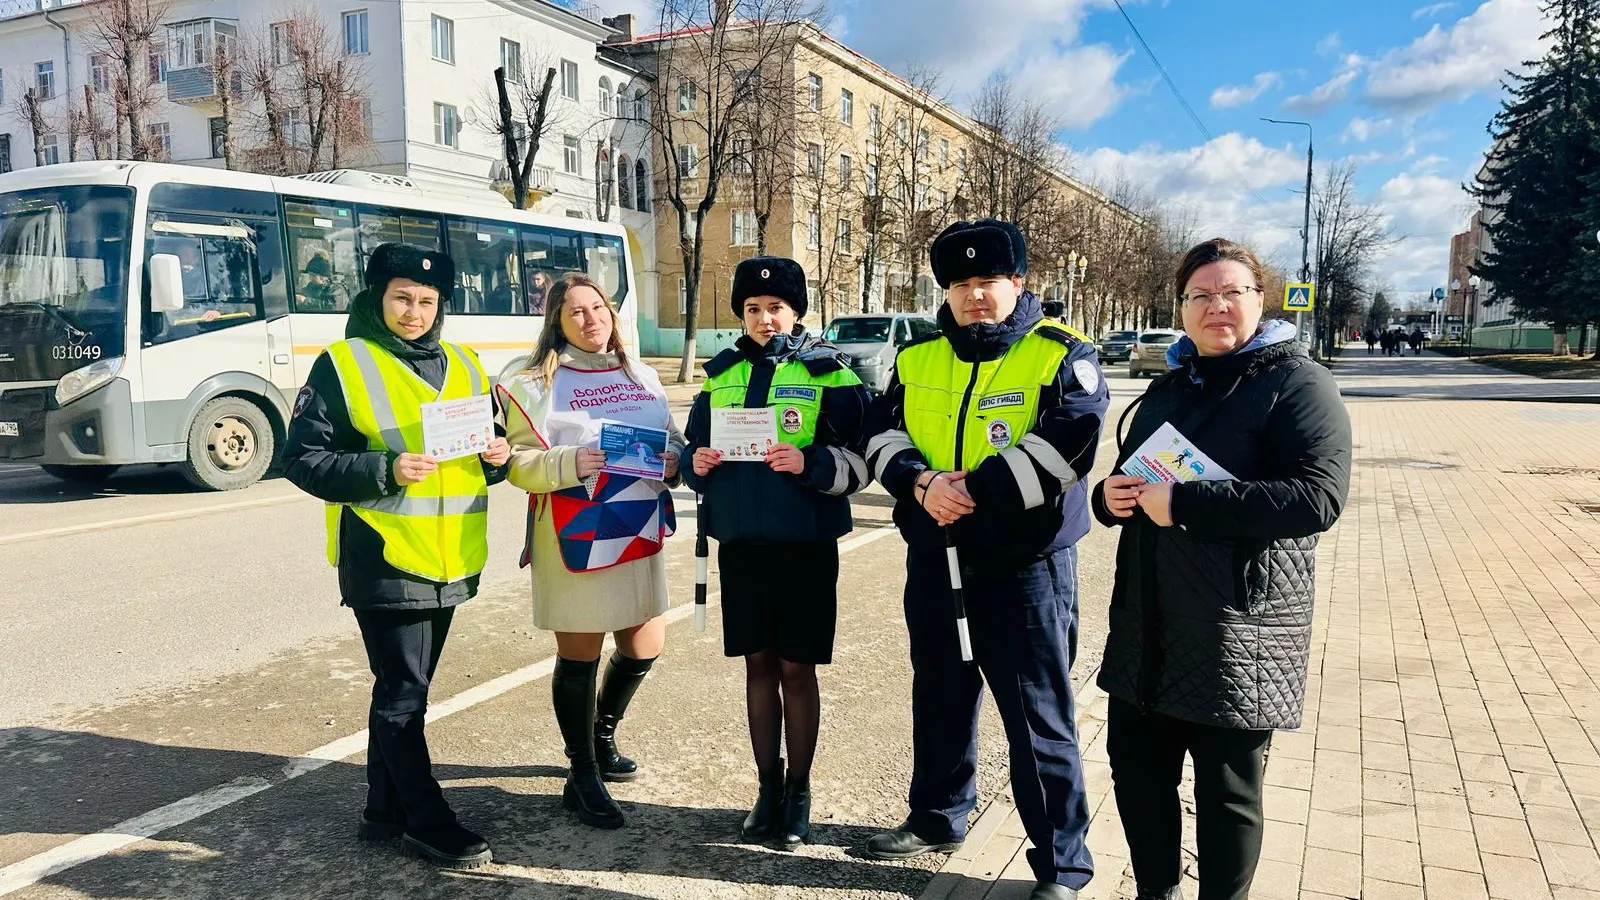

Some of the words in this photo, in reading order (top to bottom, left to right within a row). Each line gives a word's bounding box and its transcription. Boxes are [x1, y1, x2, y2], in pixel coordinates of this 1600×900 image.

[52, 345, 101, 359] 031049
[573, 383, 645, 398] ВОЛОНТЕРЫ
[569, 393, 656, 410] ПОДМОСКОВЬЯ
[980, 398, 995, 407] ДПС
[996, 394, 1022, 404] ГИБДД
[1141, 455, 1169, 482] ПОСМОТРИ
